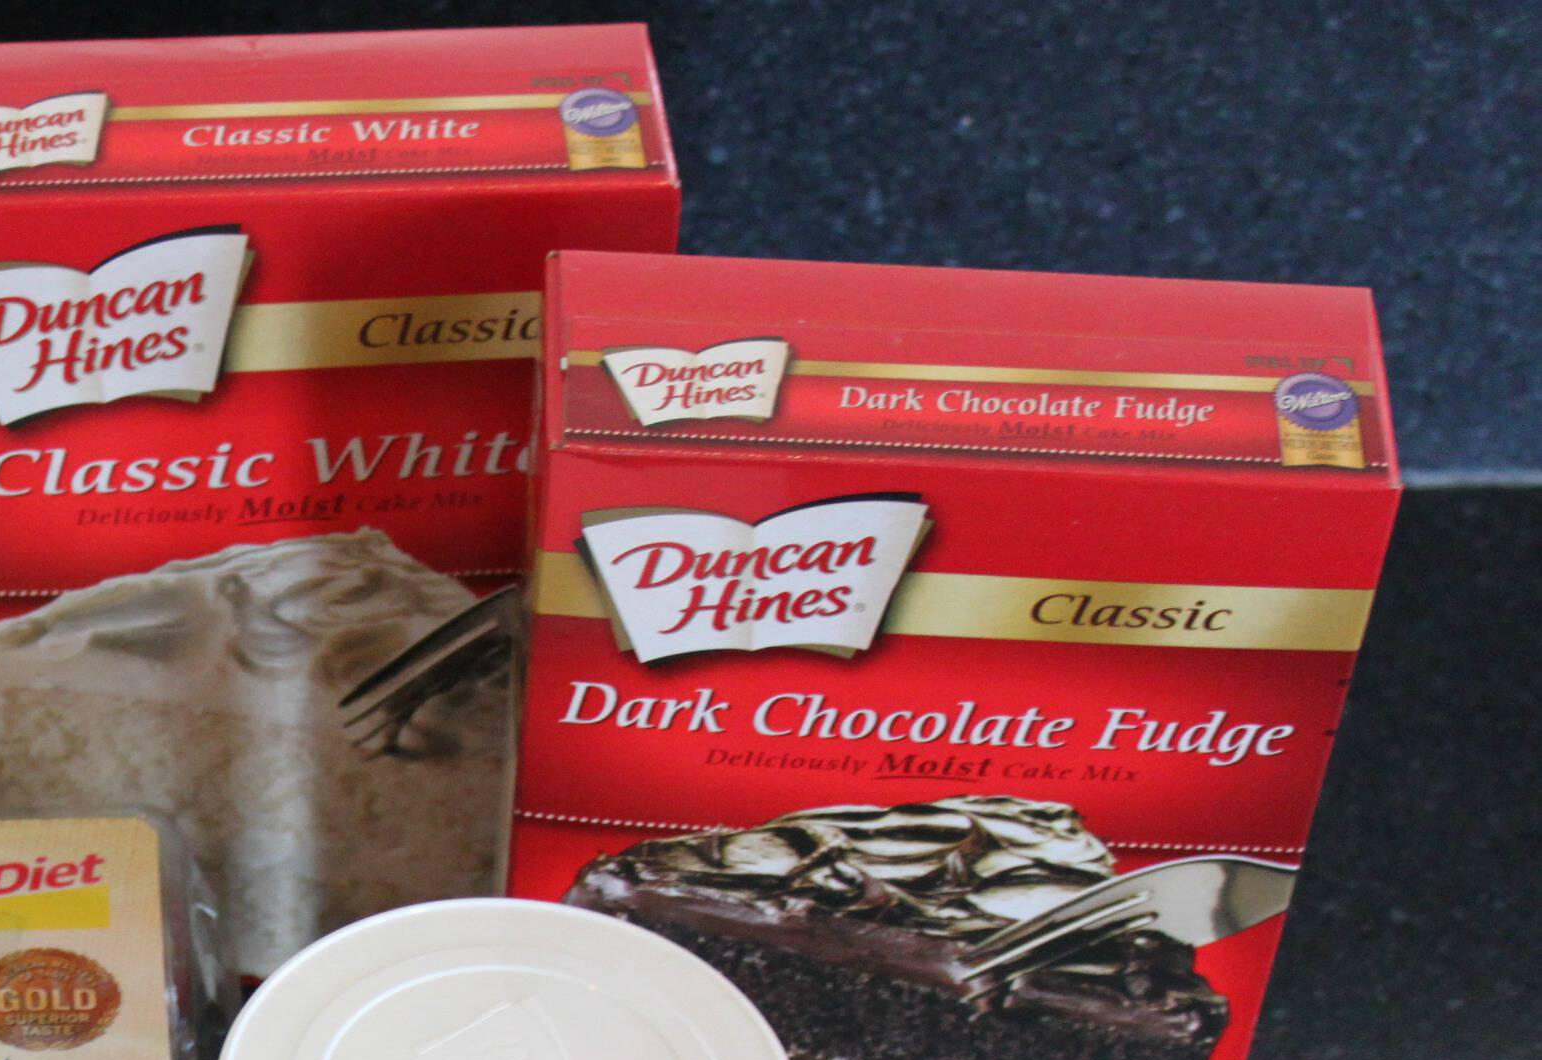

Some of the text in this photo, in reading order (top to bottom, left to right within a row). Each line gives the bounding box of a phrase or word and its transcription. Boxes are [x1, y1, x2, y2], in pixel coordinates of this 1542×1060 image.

[182, 118, 480, 149] Classic White
[359, 308, 539, 348] Classic
[14, 323, 189, 394] Hines
[621, 358, 765, 389] Duncan
[652, 383, 758, 412] Hines
[838, 385, 1216, 428] Dark Chocolate Fudge
[76, 489, 485, 528] Deliciously Moist Cake Mix
[610, 532, 877, 591] Duncan
[657, 581, 852, 636] Hines
[1029, 592, 1235, 635] Classic
[559, 680, 1296, 769] Dark Chocolate Fudge
[704, 746, 1143, 786] Deliciously Moist Cake Mix
[5, 1013, 91, 1026] SUPERIOR
[21, 1024, 75, 1037] TASTE
